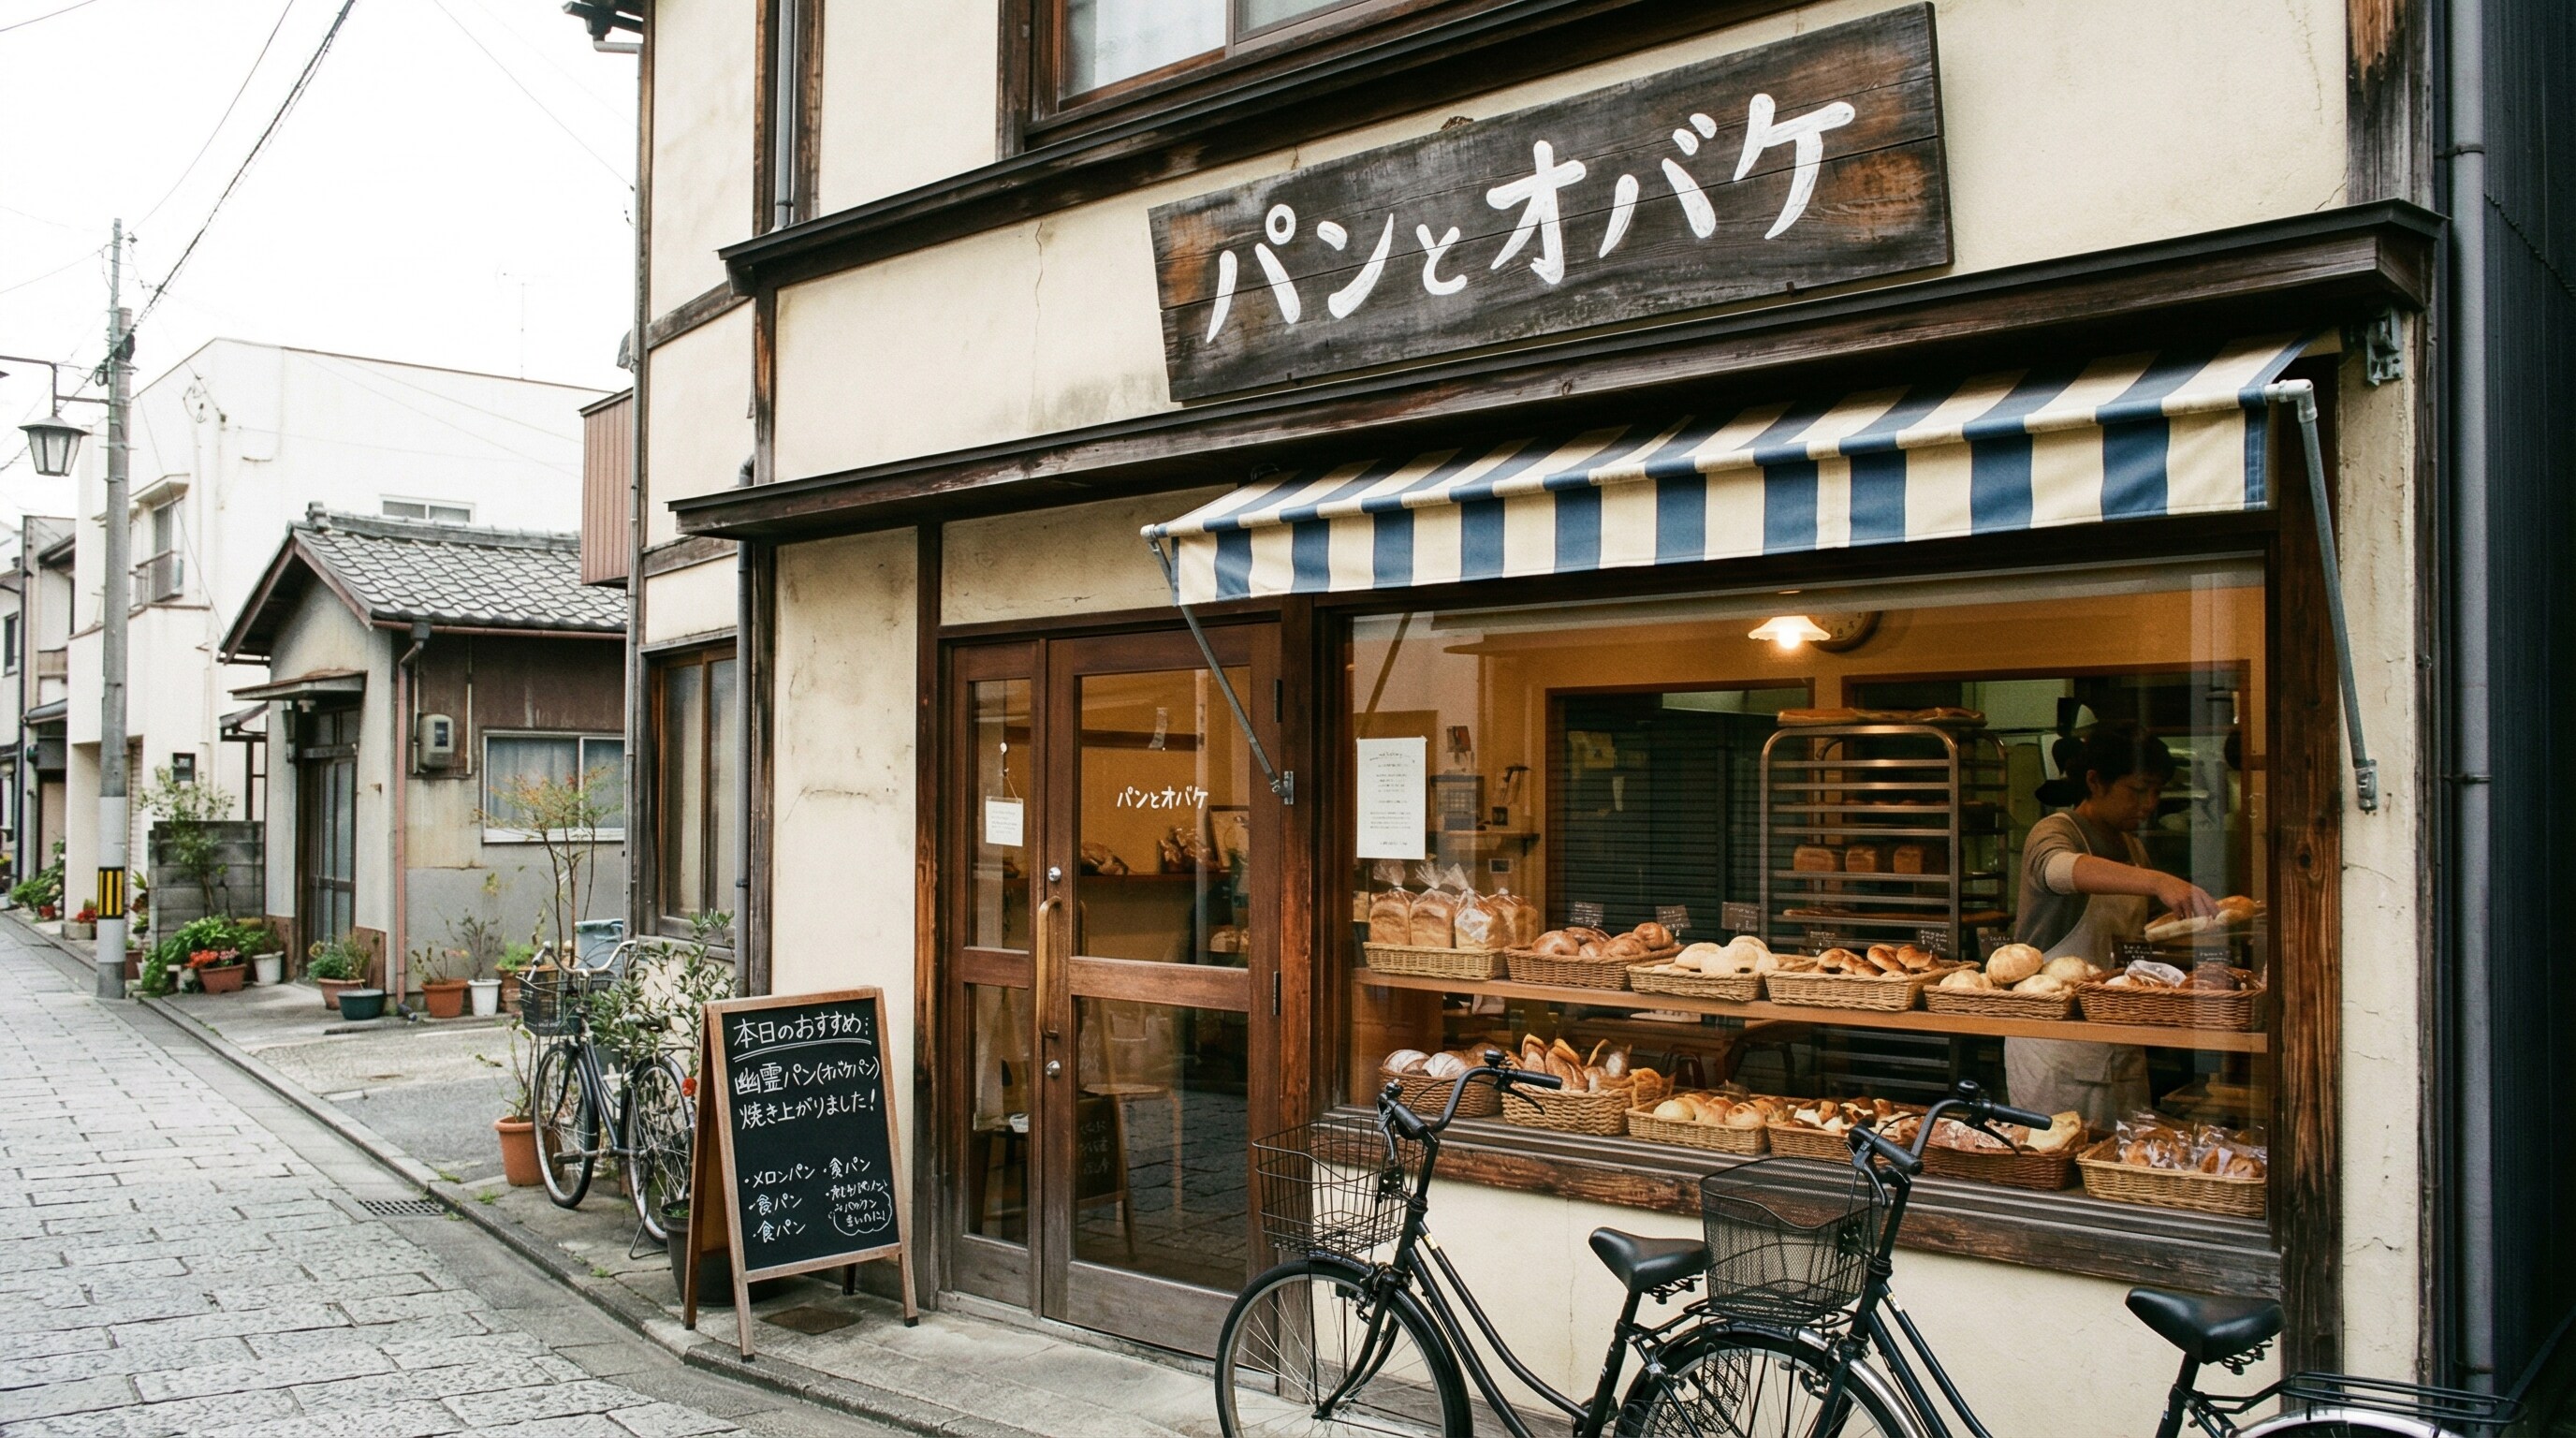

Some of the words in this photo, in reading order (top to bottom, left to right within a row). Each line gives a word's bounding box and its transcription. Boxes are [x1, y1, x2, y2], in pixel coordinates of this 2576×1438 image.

[1207, 93, 1855, 344] パンとオバケ
[1117, 785, 1208, 810] パンとオバケ
